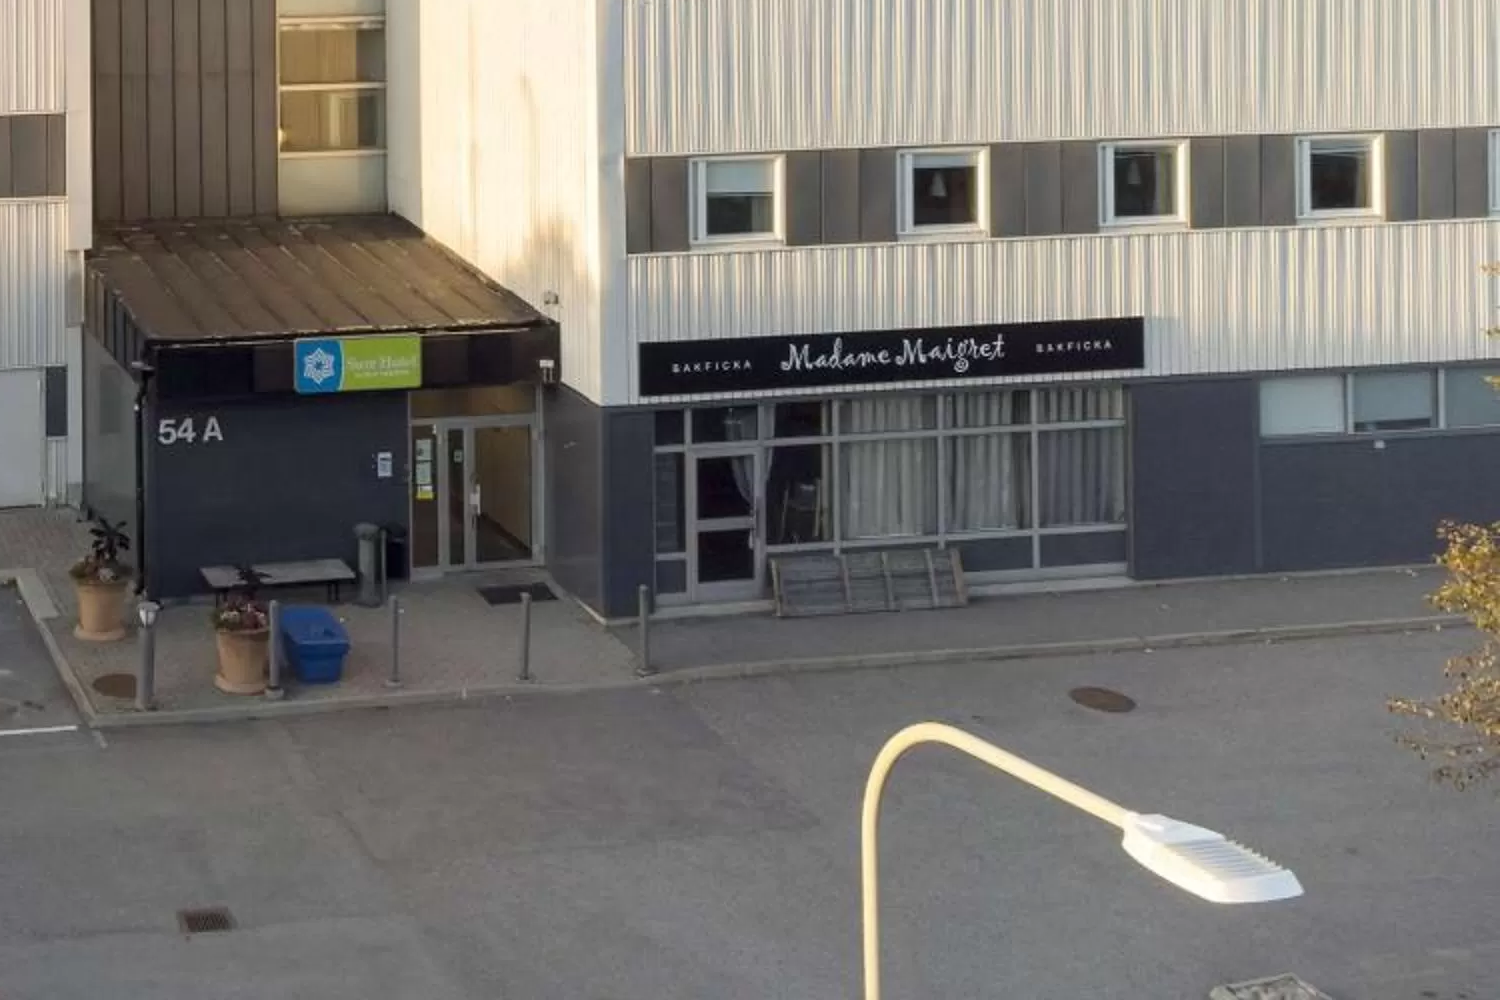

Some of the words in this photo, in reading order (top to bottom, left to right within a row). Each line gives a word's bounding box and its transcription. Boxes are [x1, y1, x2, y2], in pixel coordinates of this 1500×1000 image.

[671, 359, 752, 374] BAKFICKA
[780, 337, 890, 371] Madame
[895, 333, 1005, 373] Maigret
[1035, 339, 1113, 353] BAKFICKA
[158, 417, 196, 445] 54
[203, 415, 223, 442] A
